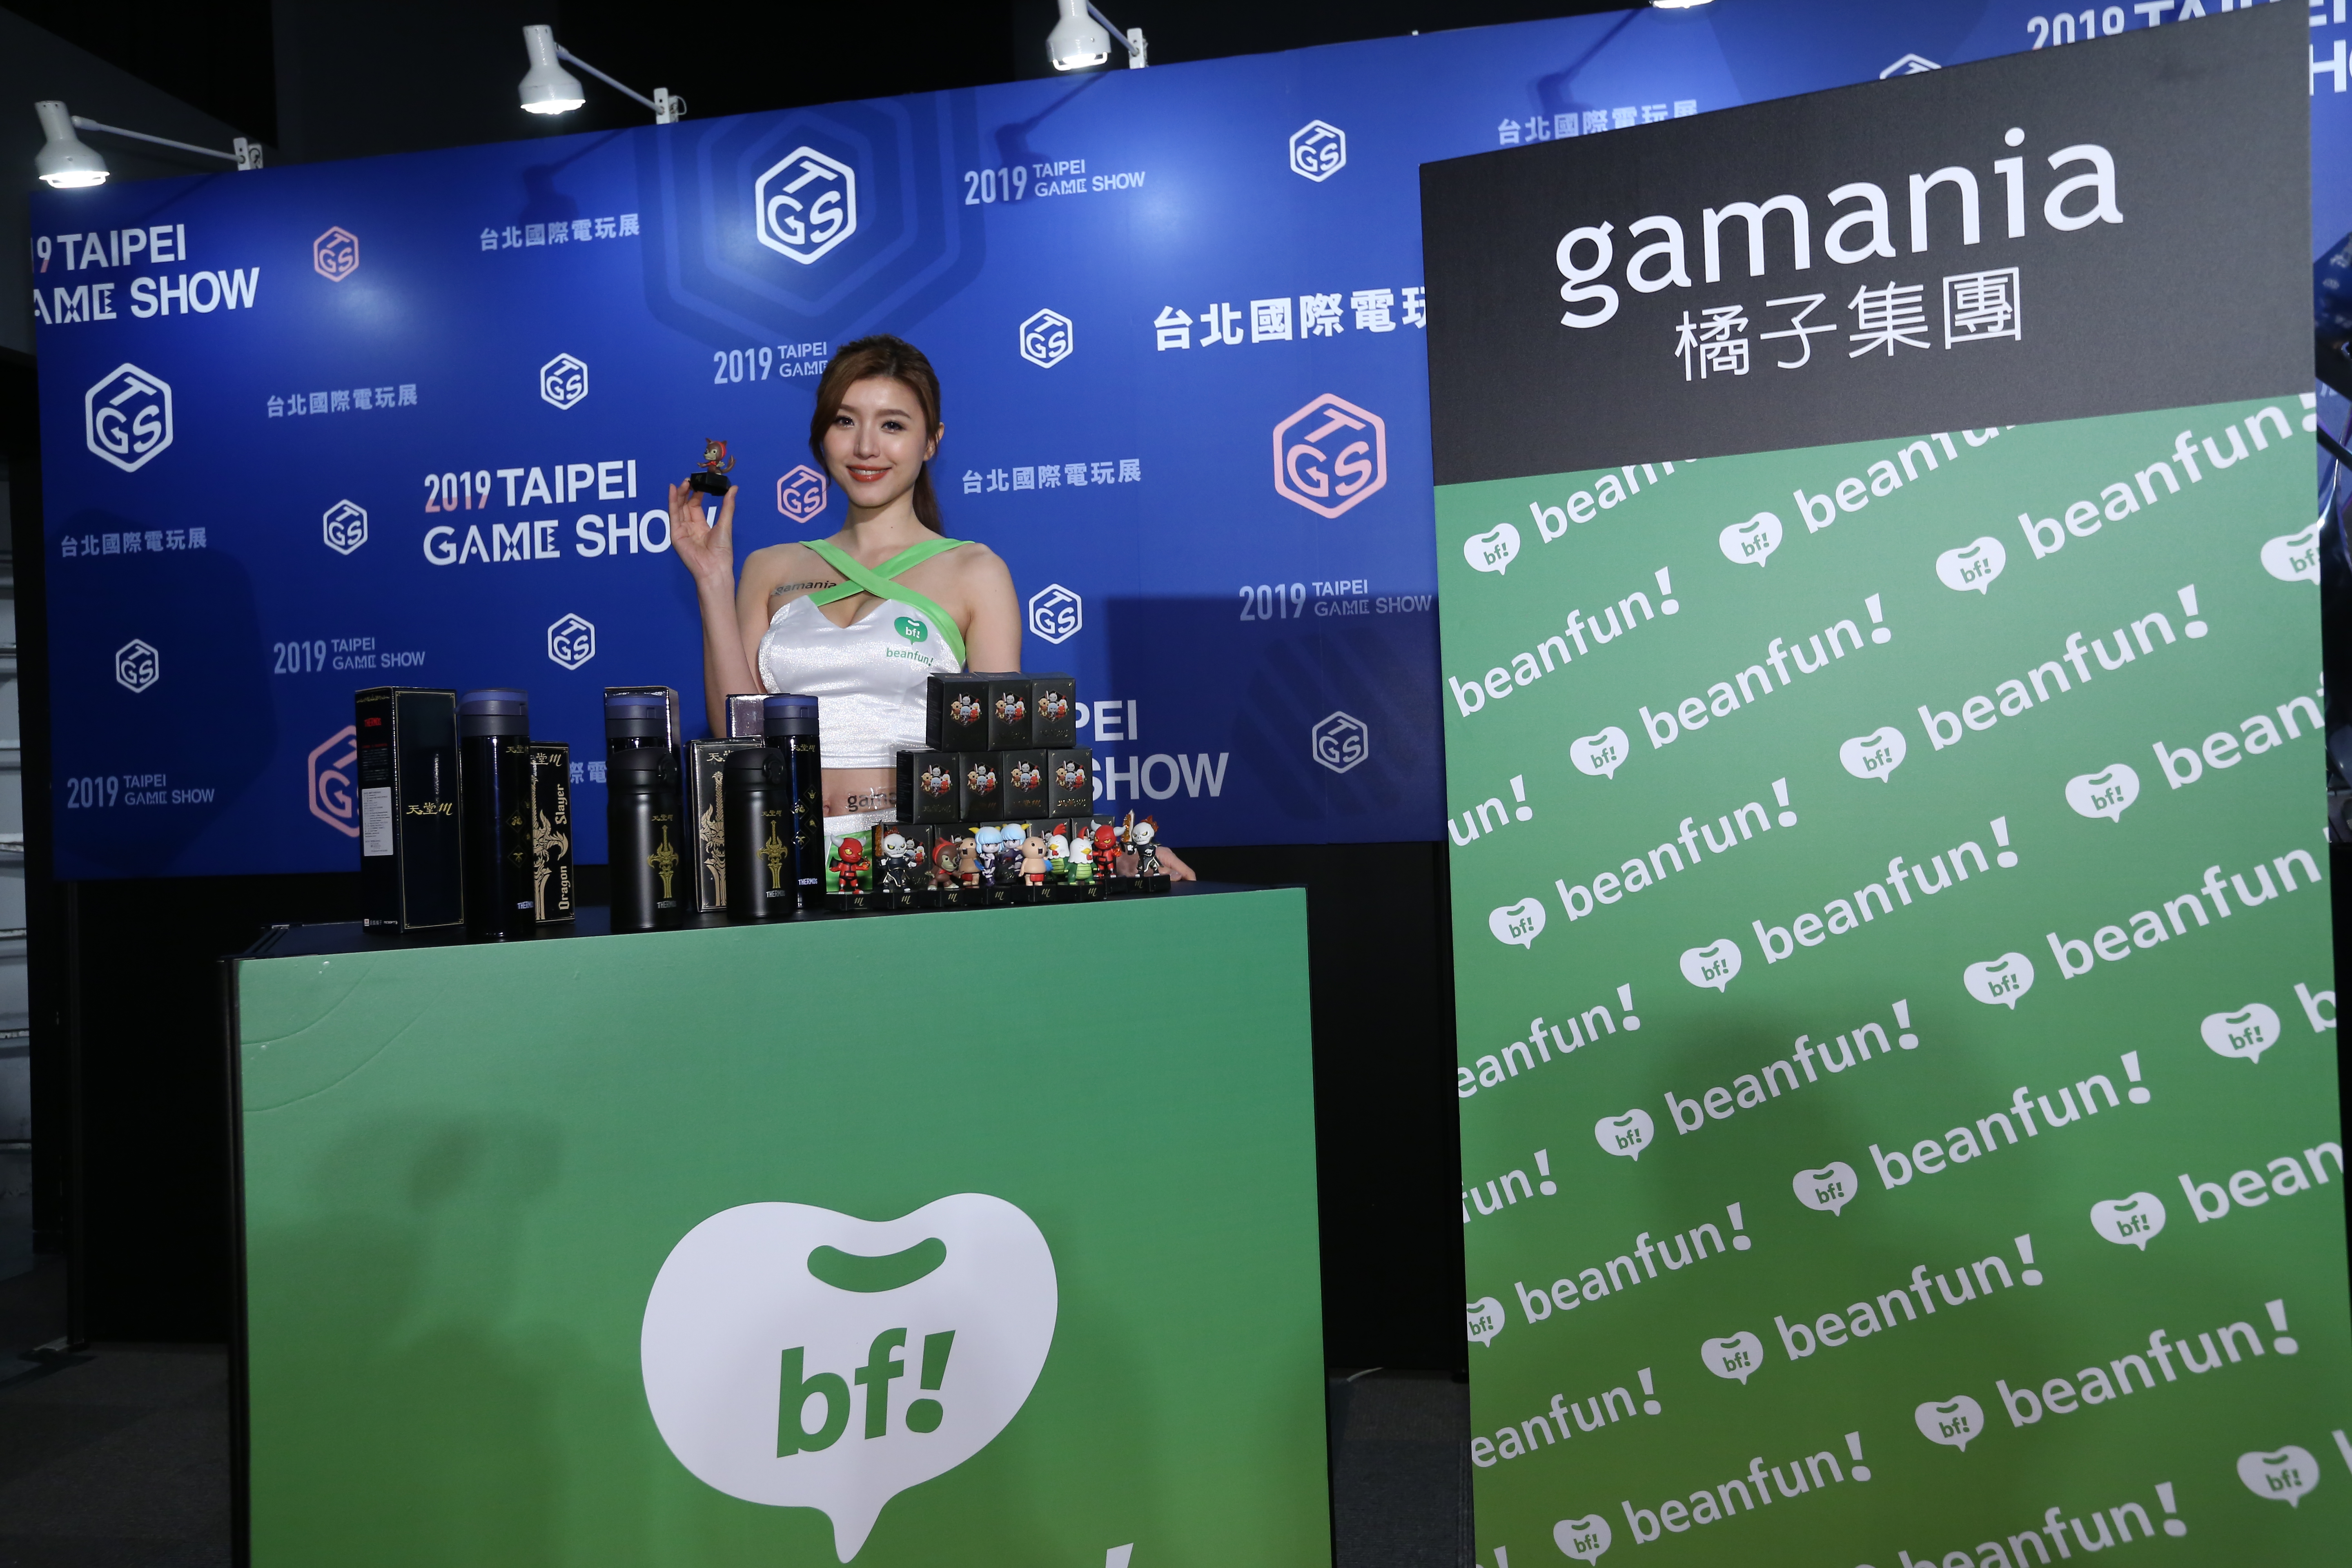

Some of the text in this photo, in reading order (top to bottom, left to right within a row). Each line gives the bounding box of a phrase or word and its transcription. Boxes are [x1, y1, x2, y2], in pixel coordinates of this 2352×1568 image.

[964, 159, 1086, 205] 2019 TAIPEI
[1035, 172, 1145, 197] GAME SHOW
[57, 224, 186, 270] TAIPEI
[481, 213, 639, 251] 台北國際電玩展
[1556, 127, 2123, 328] gamania
[131, 267, 260, 318] SHOW
[1675, 266, 2022, 381] 橘子集團
[714, 342, 826, 384] 2019 TAIPEI
[267, 384, 417, 418] 台北國際電玩展
[425, 460, 636, 512] 2019 TAIPEI
[963, 459, 1141, 494] 台北國際電玩展
[62, 527, 207, 557] 台北國際電玩展
[423, 506, 717, 565] GAME SHO
[1483, 543, 1509, 565] bf!
[1742, 533, 1769, 557] bf!
[1960, 558, 1991, 583] bf!
[1239, 579, 1368, 620] 2019 TAIPEI
[1314, 595, 1432, 616] GAME SHOW
[274, 637, 374, 674] 2019 TAIPEI
[905, 626, 920, 639] bf!
[1449, 566, 1679, 717] beanfun!
[333, 652, 425, 670] GAME SHOW
[886, 647, 934, 667] beanfun!
[1863, 584, 2208, 771] bf! beanfun!
[1590, 593, 1891, 768] bf! beanfun!
[2091, 672, 2325, 811] bf! bean
[67, 774, 166, 808] 2019 TAIPEI
[125, 789, 214, 805] GAME SHOW
[555, 784, 570, 910] Dragon Slayer
[1508, 777, 1797, 938] bf! beanfun!
[1701, 816, 2018, 981] bf! beanfun!
[1988, 827, 2329, 997] bf! beanfun
[2228, 1026, 2264, 1050] bf!
[1615, 999, 1918, 1149] bf! beanfun!
[1815, 1051, 2150, 1204] bf! beanfun!
[2116, 1214, 2150, 1237] bf!
[1468, 1202, 1751, 1336] bf! beanfun!
[1722, 1234, 2042, 1372] bf! beanfun!
[1938, 1299, 2298, 1438] bf! beanfun!
[777, 1327, 956, 1458] bf!
[1573, 1432, 1871, 1553] bf! beanfun!
[2266, 1469, 2302, 1492] bf!
